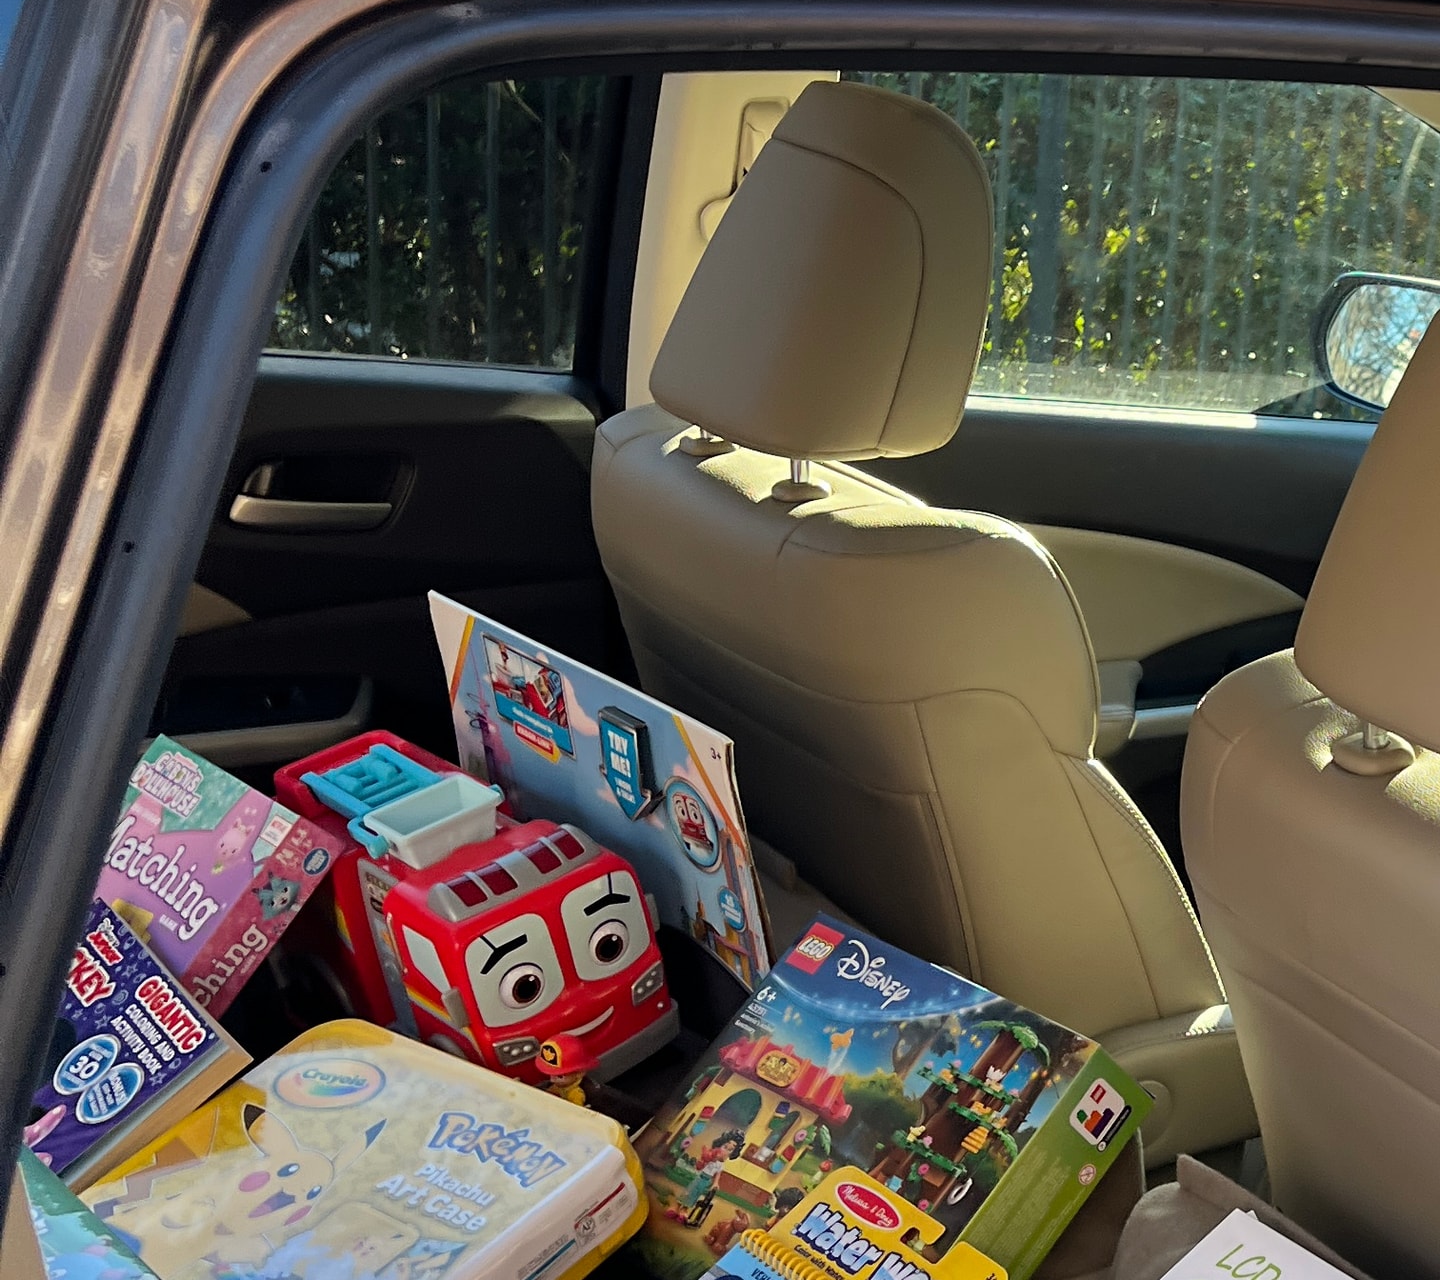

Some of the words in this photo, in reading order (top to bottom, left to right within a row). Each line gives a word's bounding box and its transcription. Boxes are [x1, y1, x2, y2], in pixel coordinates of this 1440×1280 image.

[607, 730, 628, 756] TRY
[131, 764, 199, 817] DOLLHOUSE
[156, 752, 201, 792] GABBY'S
[799, 936, 834, 960] LEGO
[136, 976, 205, 1053] GIGANTIC
[756, 985, 777, 1003] 6+
[111, 1015, 145, 1054] ACTIVITY
[137, 1046, 163, 1076] BOOK
[125, 1003, 162, 1044] COLORING
[156, 1041, 176, 1063] AND
[69, 1054, 100, 1079] 30
[302, 1067, 369, 1089] Crayola
[374, 1173, 426, 1209] Art
[423, 1192, 488, 1235] Case
[413, 1163, 498, 1208] Pikachu
[797, 1202, 884, 1275] Water
[877, 1207, 894, 1228] Doug
